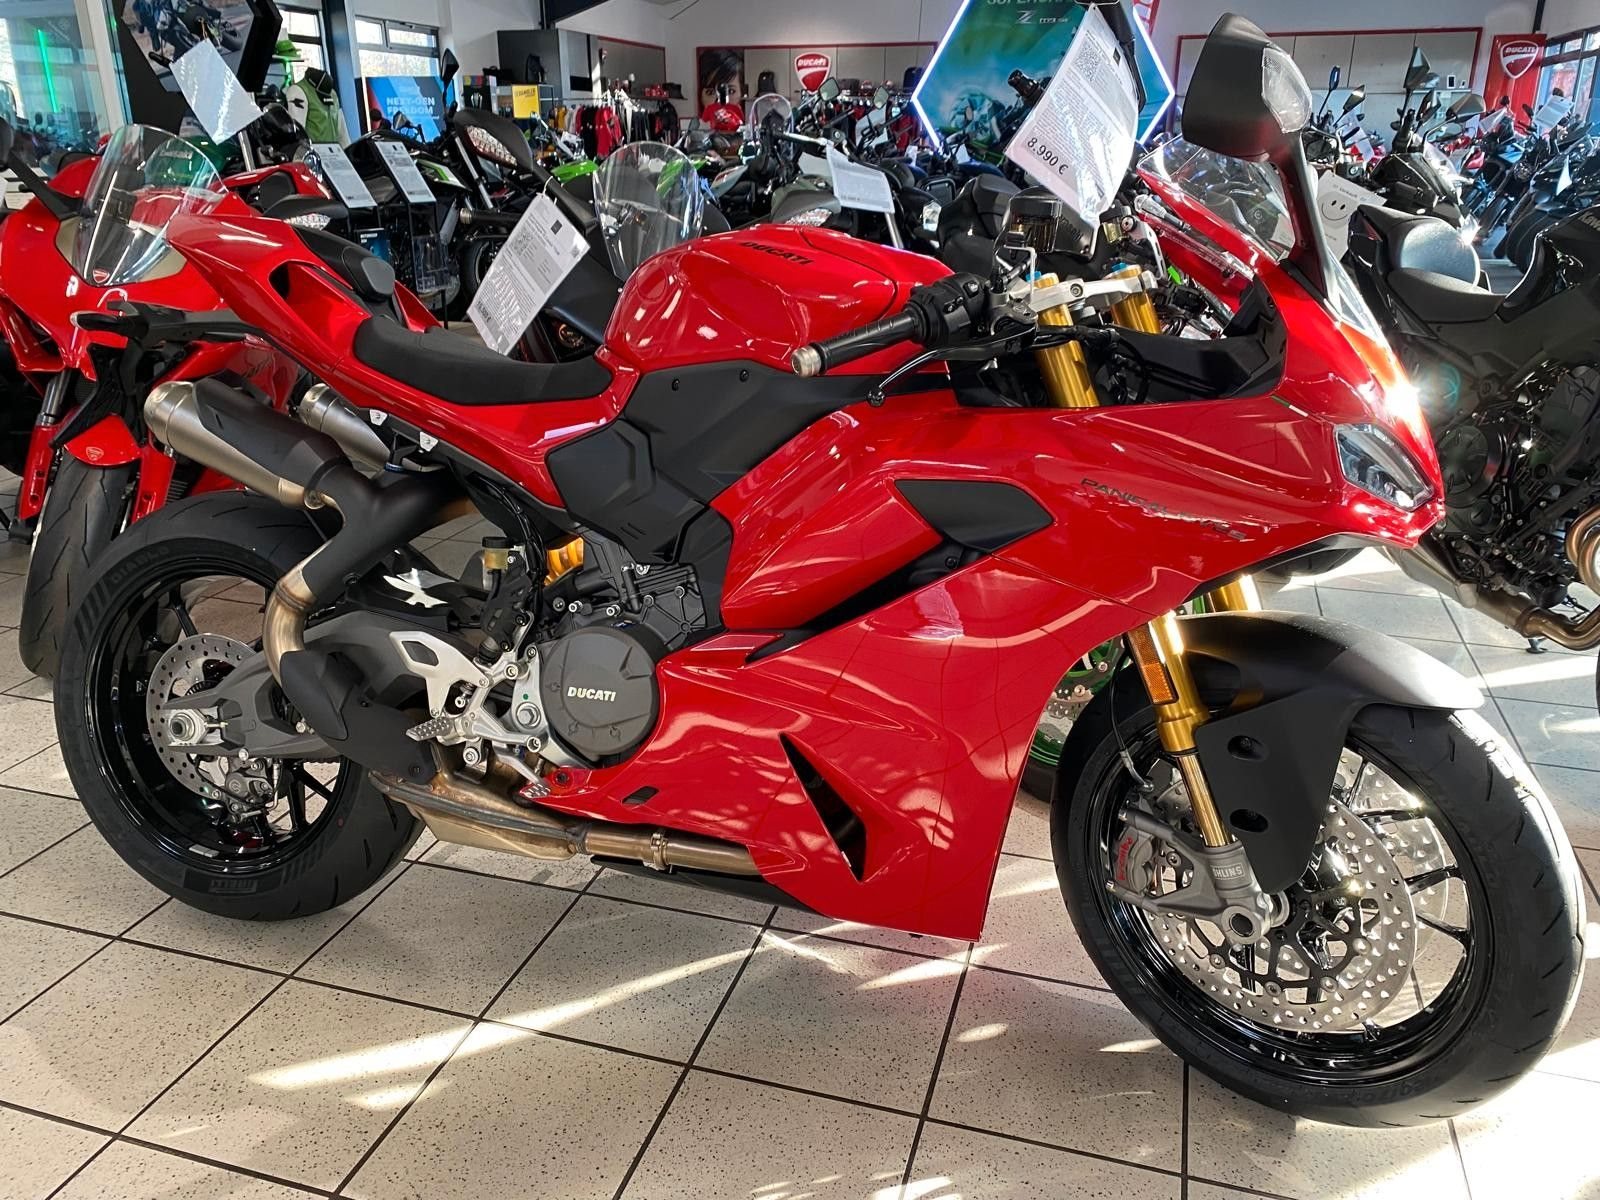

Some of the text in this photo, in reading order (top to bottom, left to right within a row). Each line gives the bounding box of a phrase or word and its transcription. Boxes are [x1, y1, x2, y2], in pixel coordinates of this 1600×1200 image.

[797, 58, 826, 67] DUCATI
[1027, 137, 1069, 175] 8.990 €
[740, 241, 814, 264] DUCATI
[567, 686, 617, 702] DUCATI
